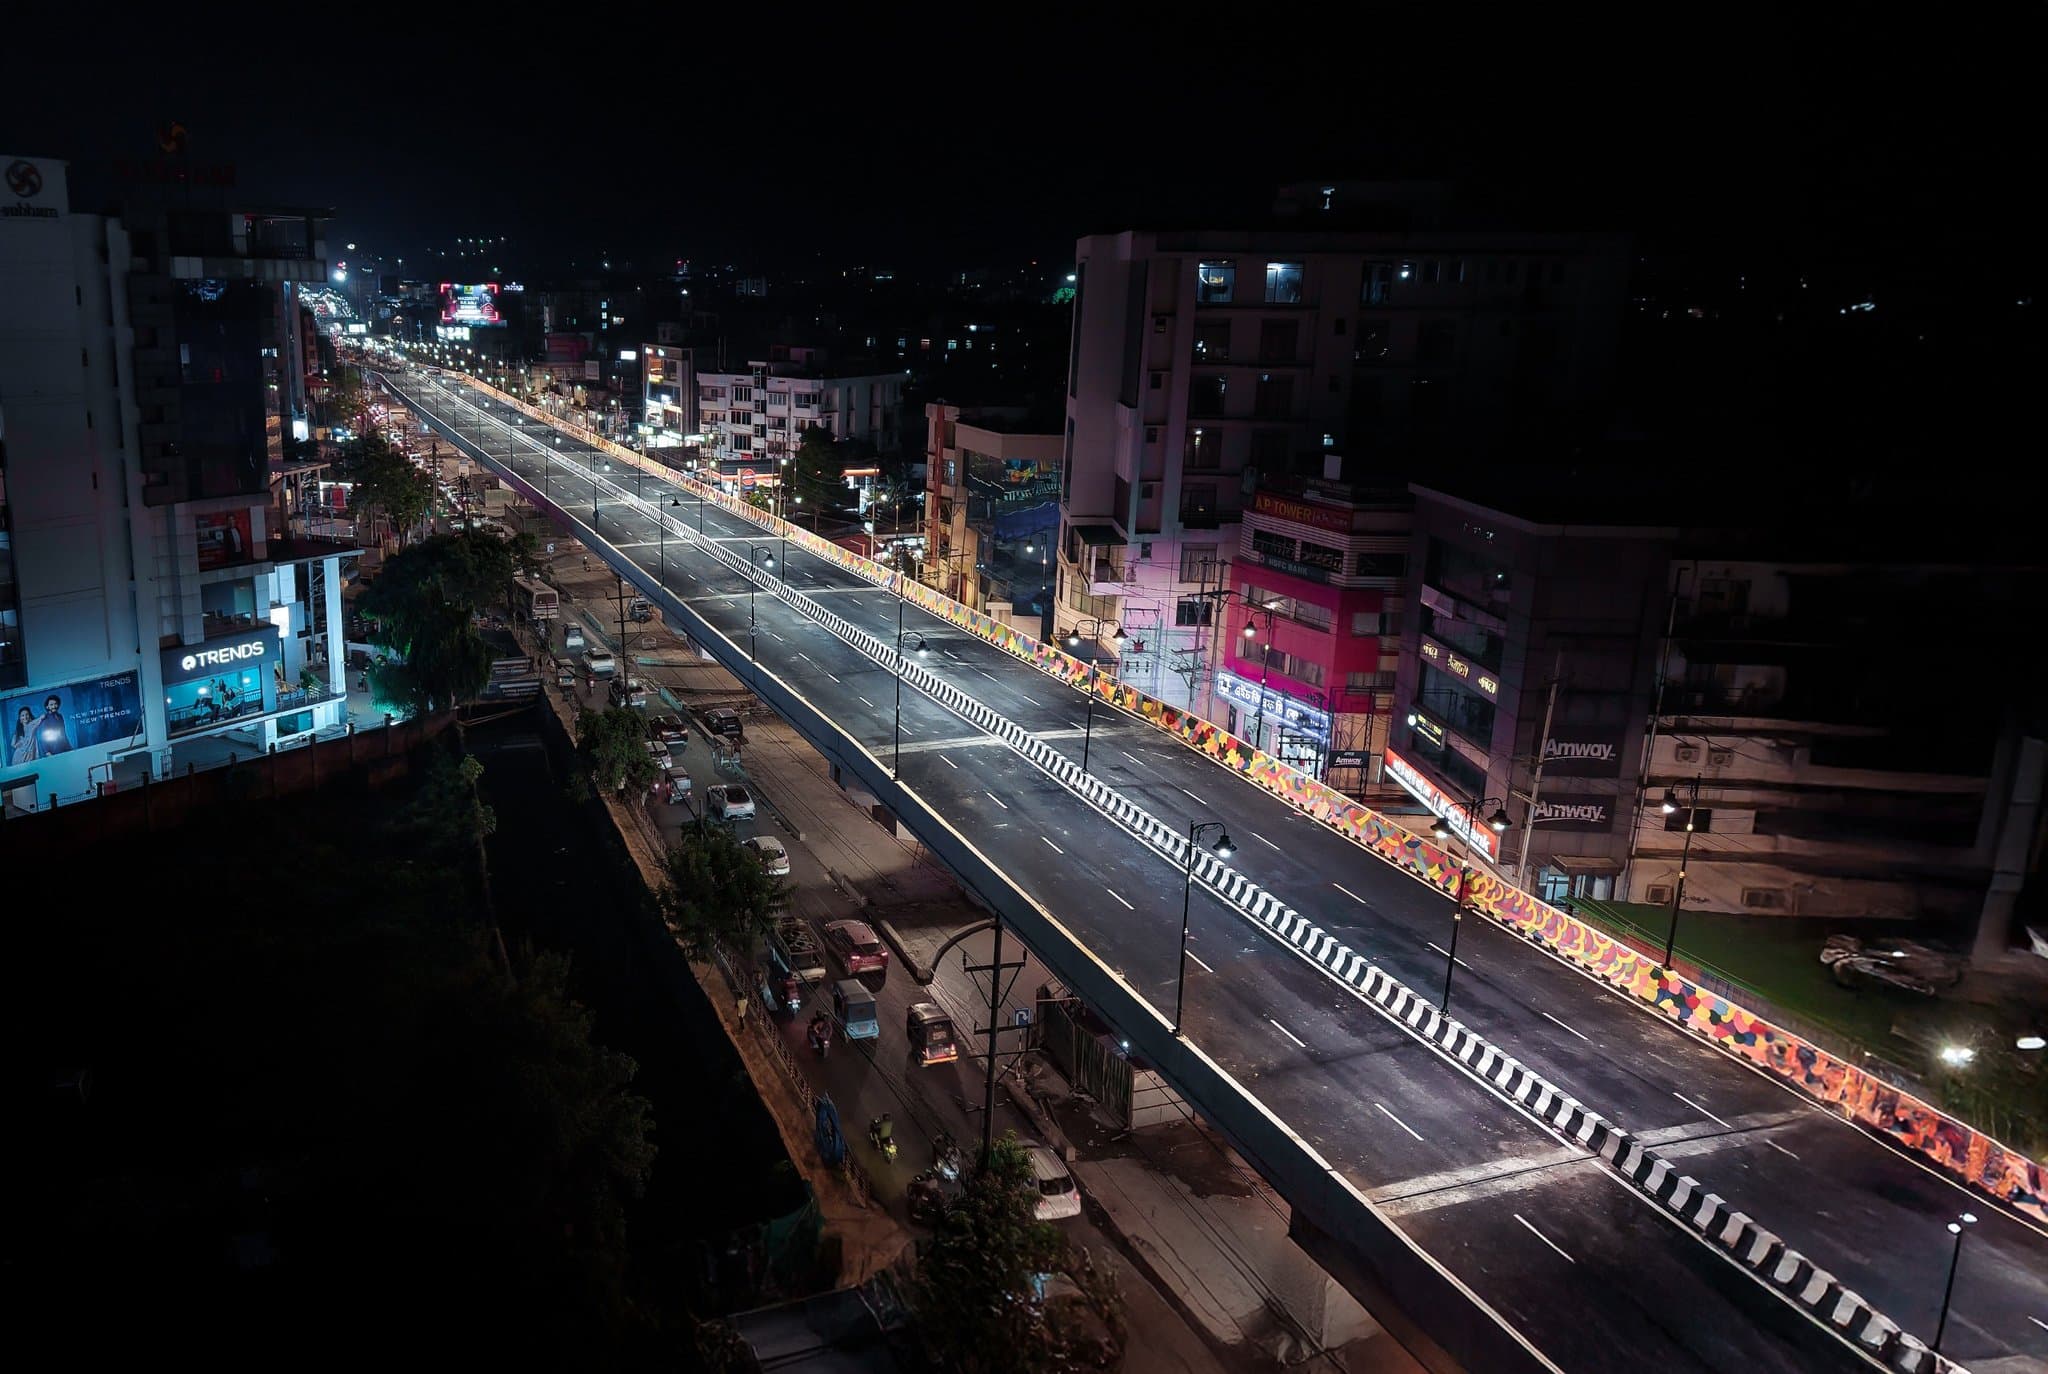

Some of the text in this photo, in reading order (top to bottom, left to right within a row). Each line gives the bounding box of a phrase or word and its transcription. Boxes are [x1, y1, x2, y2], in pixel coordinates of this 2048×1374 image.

[1273, 500, 1313, 522] TOWER
[1268, 558, 1308, 577] HDFC BANK
[196, 640, 265, 667] TRENDS
[99, 676, 131, 689] TRENDS
[70, 705, 114, 720] NEW TIMES
[80, 709, 131, 725] NEW TRENDS
[1545, 737, 1611, 759] Amway
[1335, 756, 1362, 766] Amway
[1535, 799, 1602, 822] Amway
